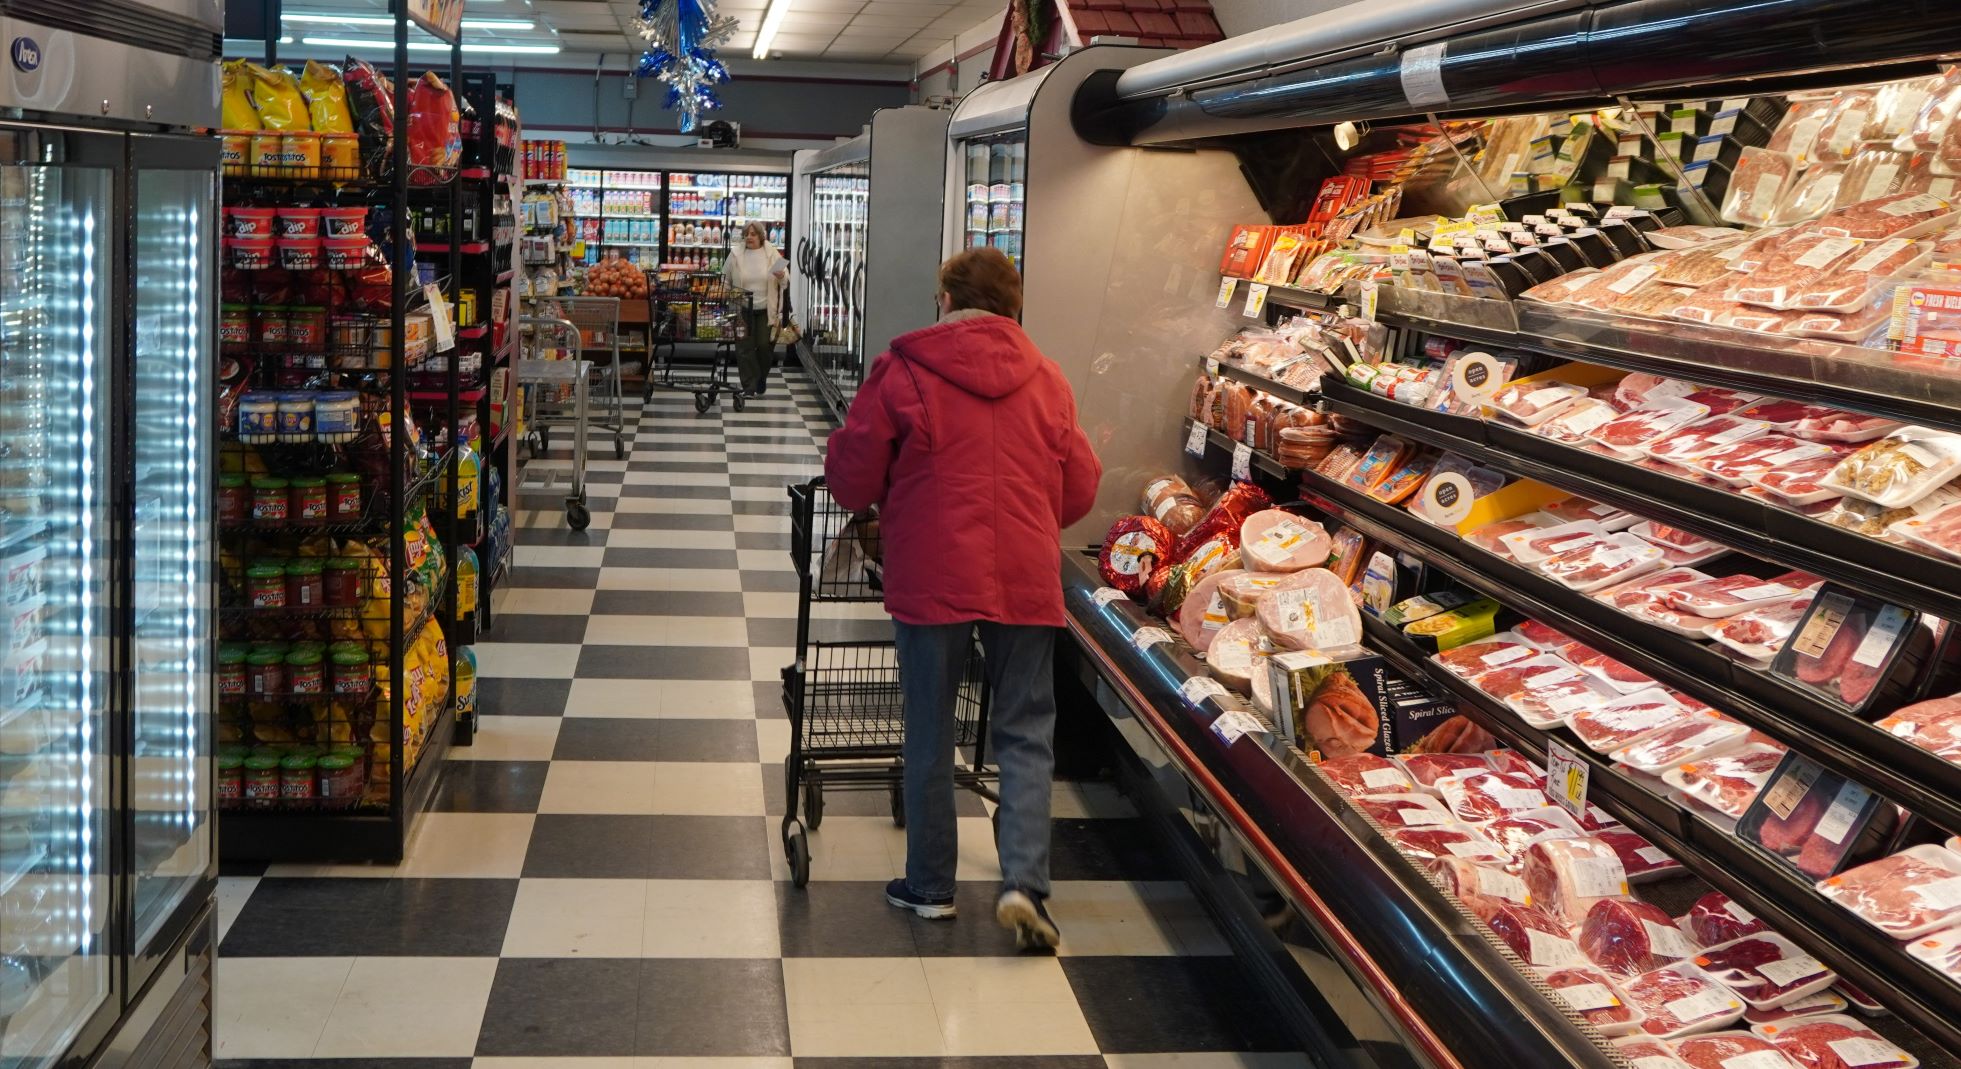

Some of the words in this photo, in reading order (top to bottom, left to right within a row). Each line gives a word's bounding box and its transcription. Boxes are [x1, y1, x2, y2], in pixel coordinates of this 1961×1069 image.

[239, 222, 257, 233] dip
[287, 222, 306, 233] dip
[341, 222, 359, 234] dip
[1438, 486, 1454, 496] open
[1374, 667, 1387, 694] Spiral
[1379, 695, 1390, 722] Sliced
[1409, 709, 1434, 720] Spiral
[1436, 706, 1456, 715] Slic
[1382, 722, 1394, 753] Glazed
